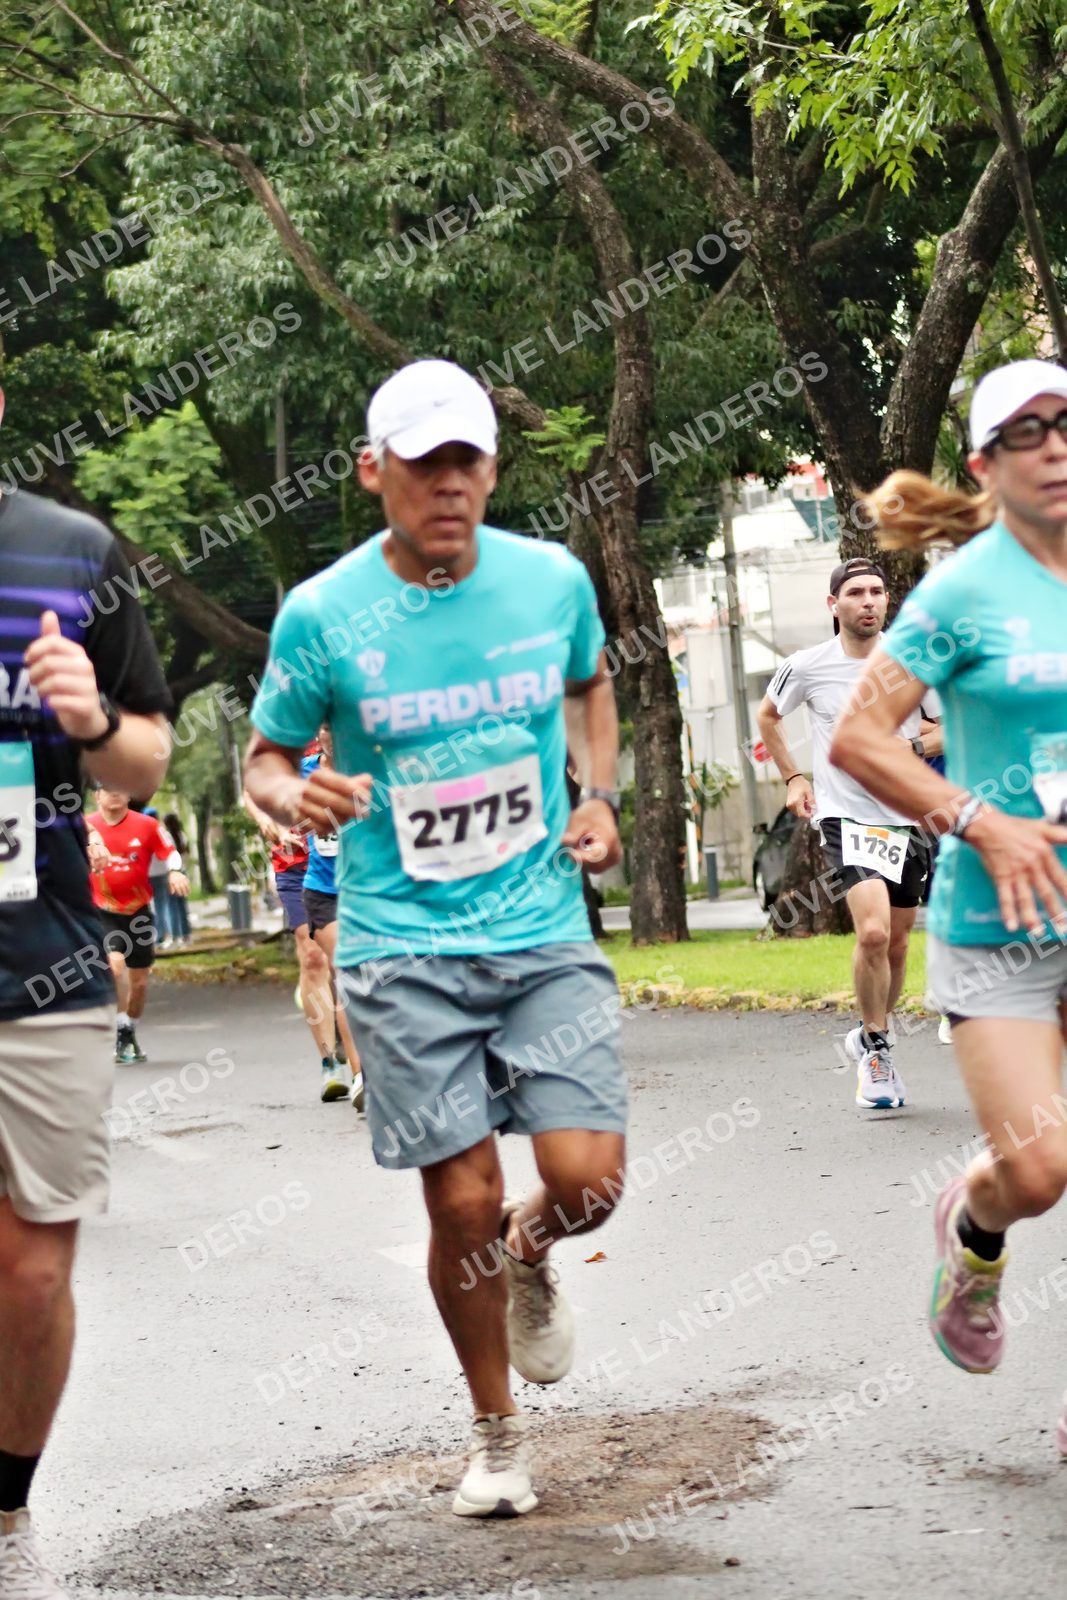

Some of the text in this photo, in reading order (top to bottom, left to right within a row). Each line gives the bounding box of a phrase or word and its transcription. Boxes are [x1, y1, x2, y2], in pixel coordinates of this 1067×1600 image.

[1006, 653, 1067, 687] PE
[359, 663, 564, 735] PERDURA
[408, 784, 532, 849] 2775
[850, 834, 902, 865] 1726
